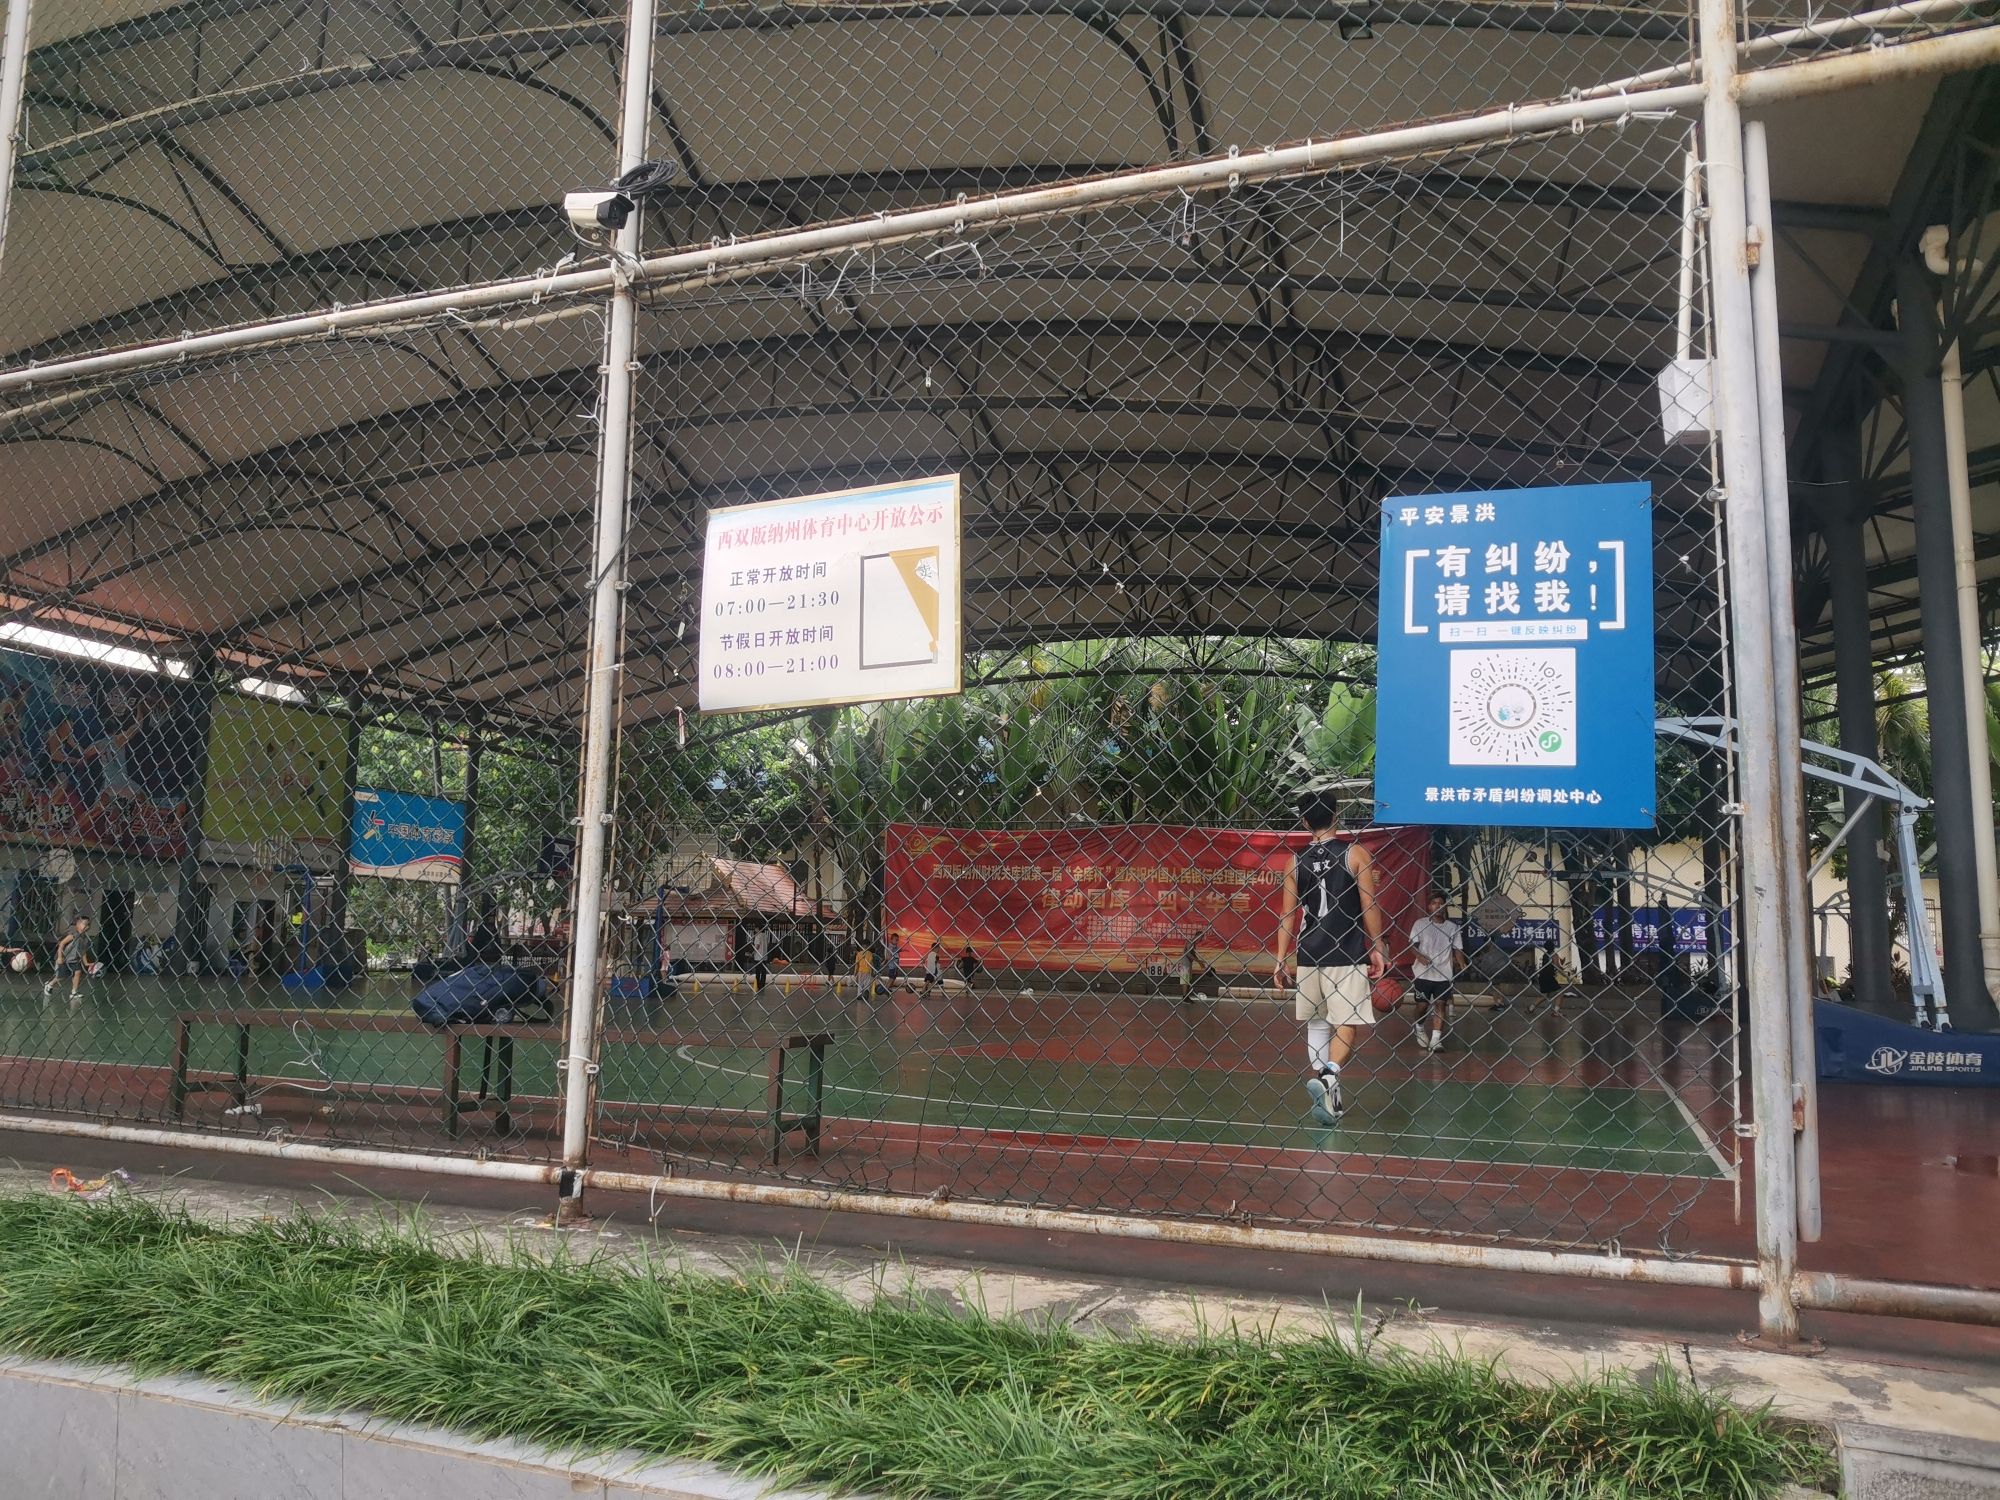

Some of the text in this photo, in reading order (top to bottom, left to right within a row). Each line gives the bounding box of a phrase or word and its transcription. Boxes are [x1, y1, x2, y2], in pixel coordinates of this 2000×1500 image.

[717, 501, 944, 551] 西双版纳州体育中心开放公示
[1399, 503, 1496, 526] 平安景洪
[729, 561, 828, 587] 正常开放时间
[719, 624, 834, 651] 节假日开放时间
[1424, 786, 1602, 805] 景洪市矛盾纠纷调处中心
[1317, 878, 1329, 918] 1
[1908, 1051, 1983, 1066] 金陵体育
